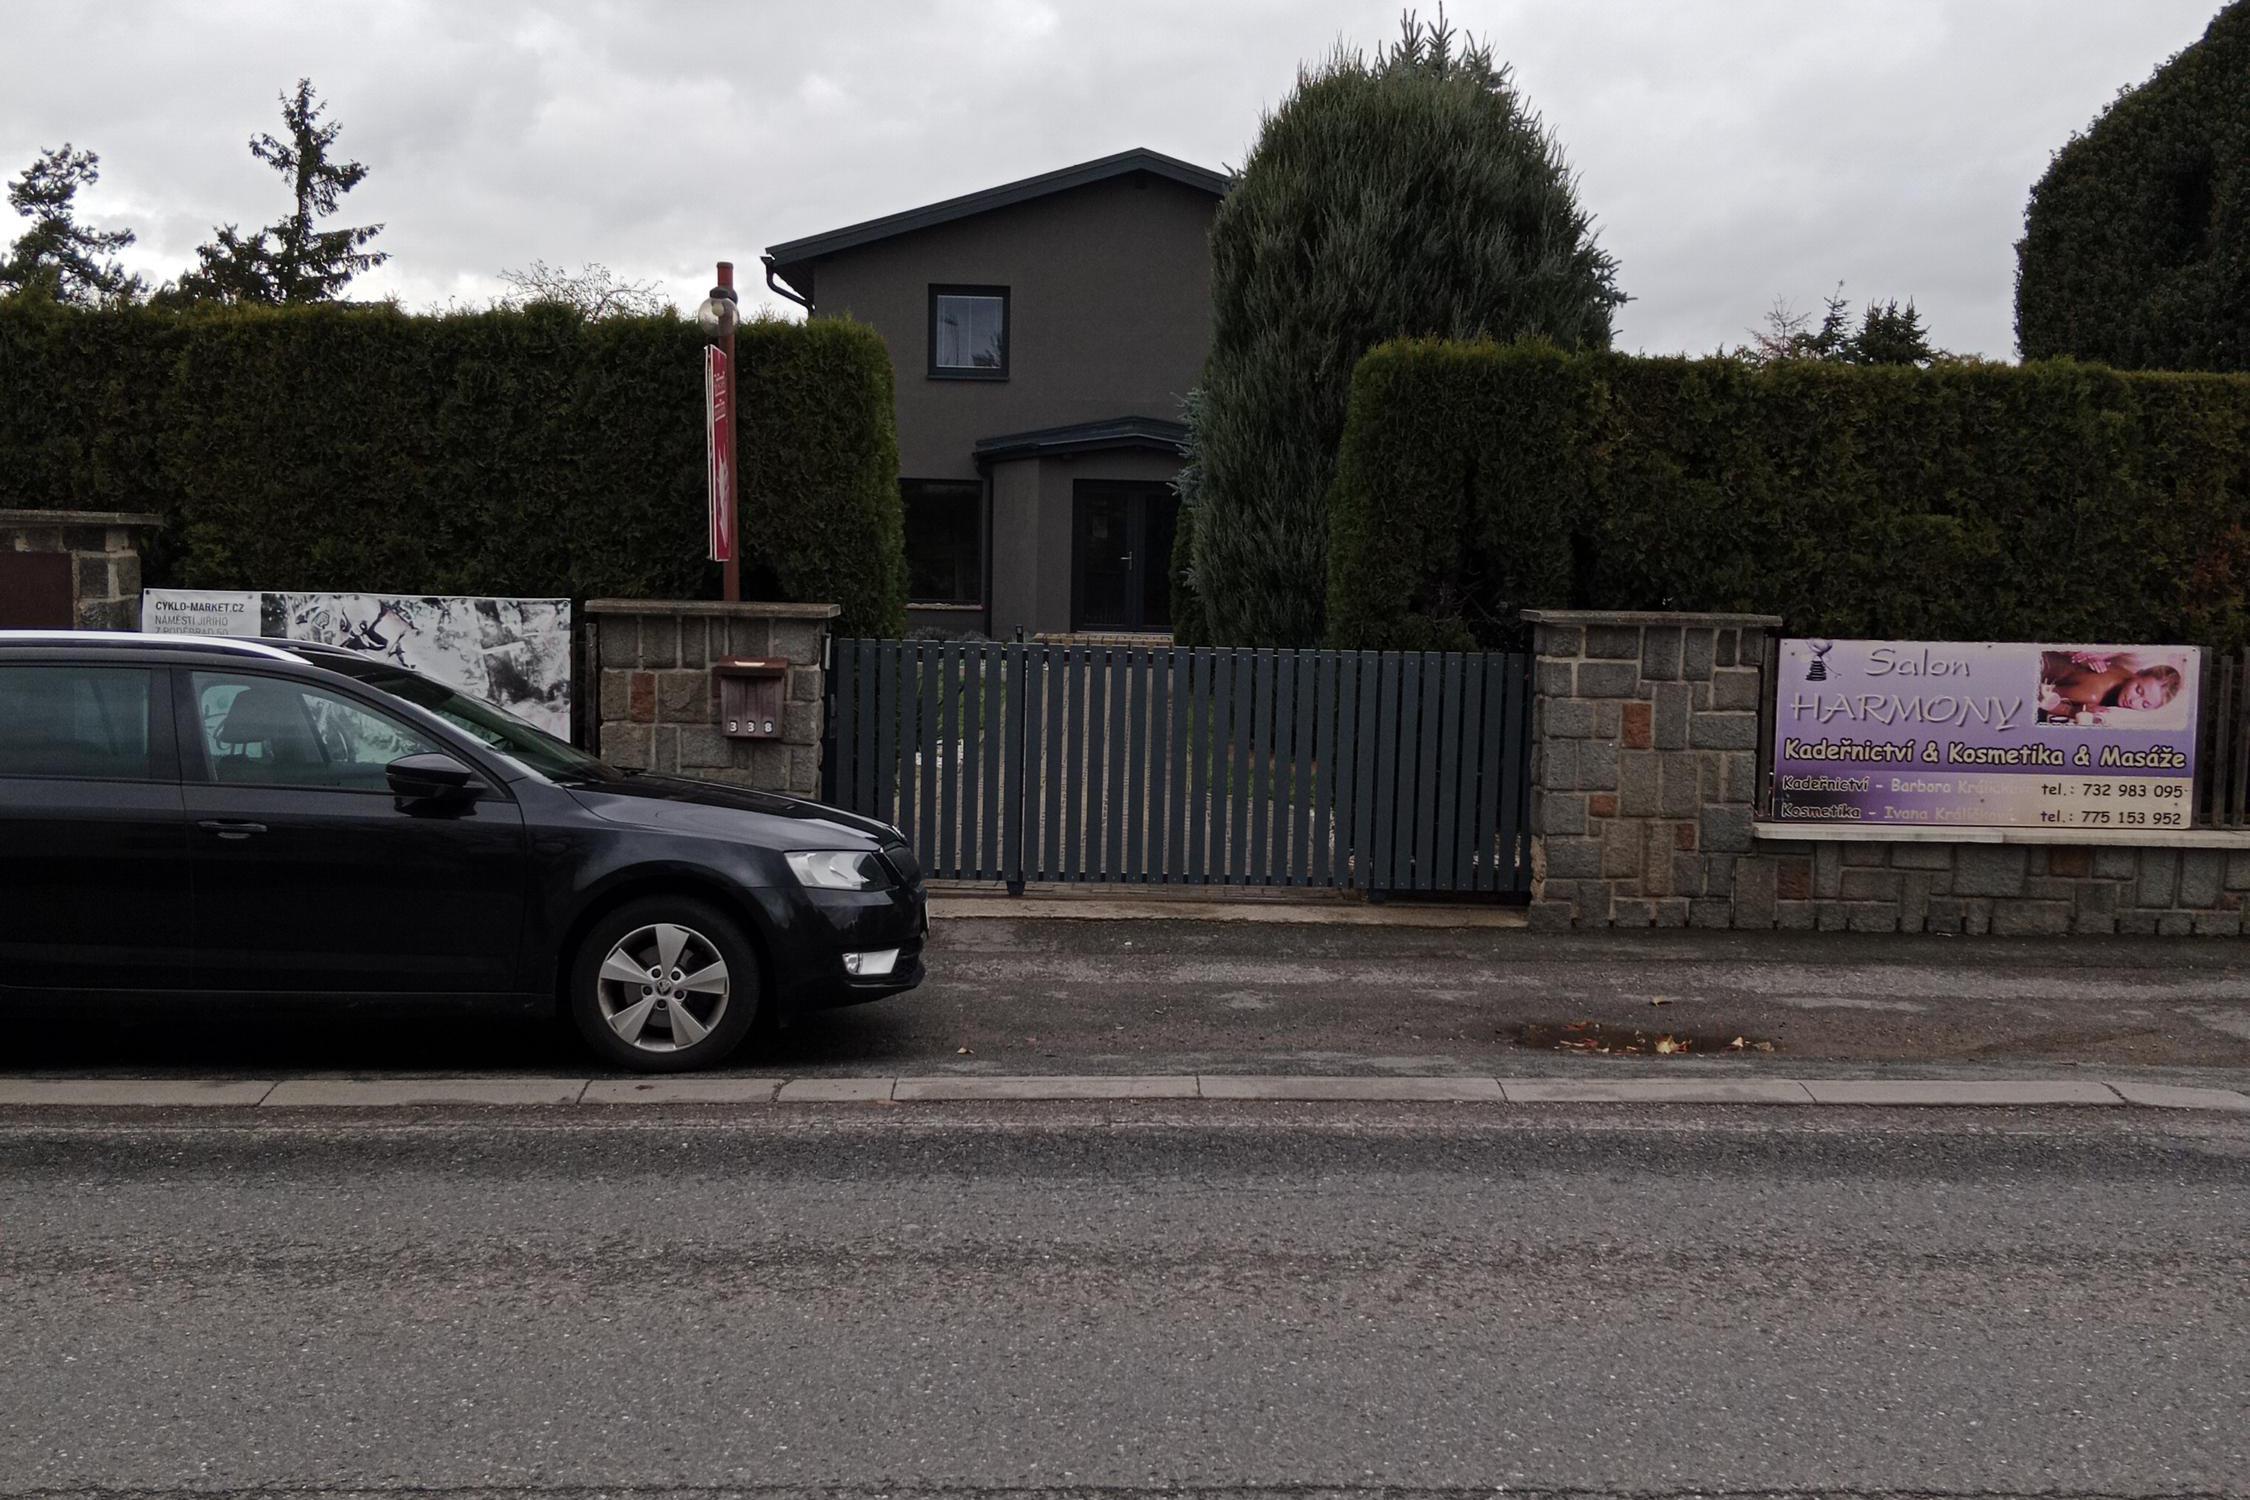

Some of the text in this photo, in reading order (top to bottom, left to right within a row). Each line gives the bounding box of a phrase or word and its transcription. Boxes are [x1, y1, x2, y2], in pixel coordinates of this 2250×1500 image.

[155, 601, 245, 613] CYKLO-MARKET.CZ
[1866, 648, 1971, 677] Salon
[1790, 693, 2023, 732] HARMONY
[1784, 737, 2186, 768] Kadeřnictví & Kosmetika & Masáže
[1782, 775, 1870, 792] Kadeřnictví
[1891, 778, 1952, 793] Barbora
[2041, 783, 2183, 798] tel.: 732 983 095
[1781, 803, 1861, 819] Kosmetika
[1884, 806, 1928, 820] Ivana
[2040, 810, 2181, 825] tel.: 775 153 952
